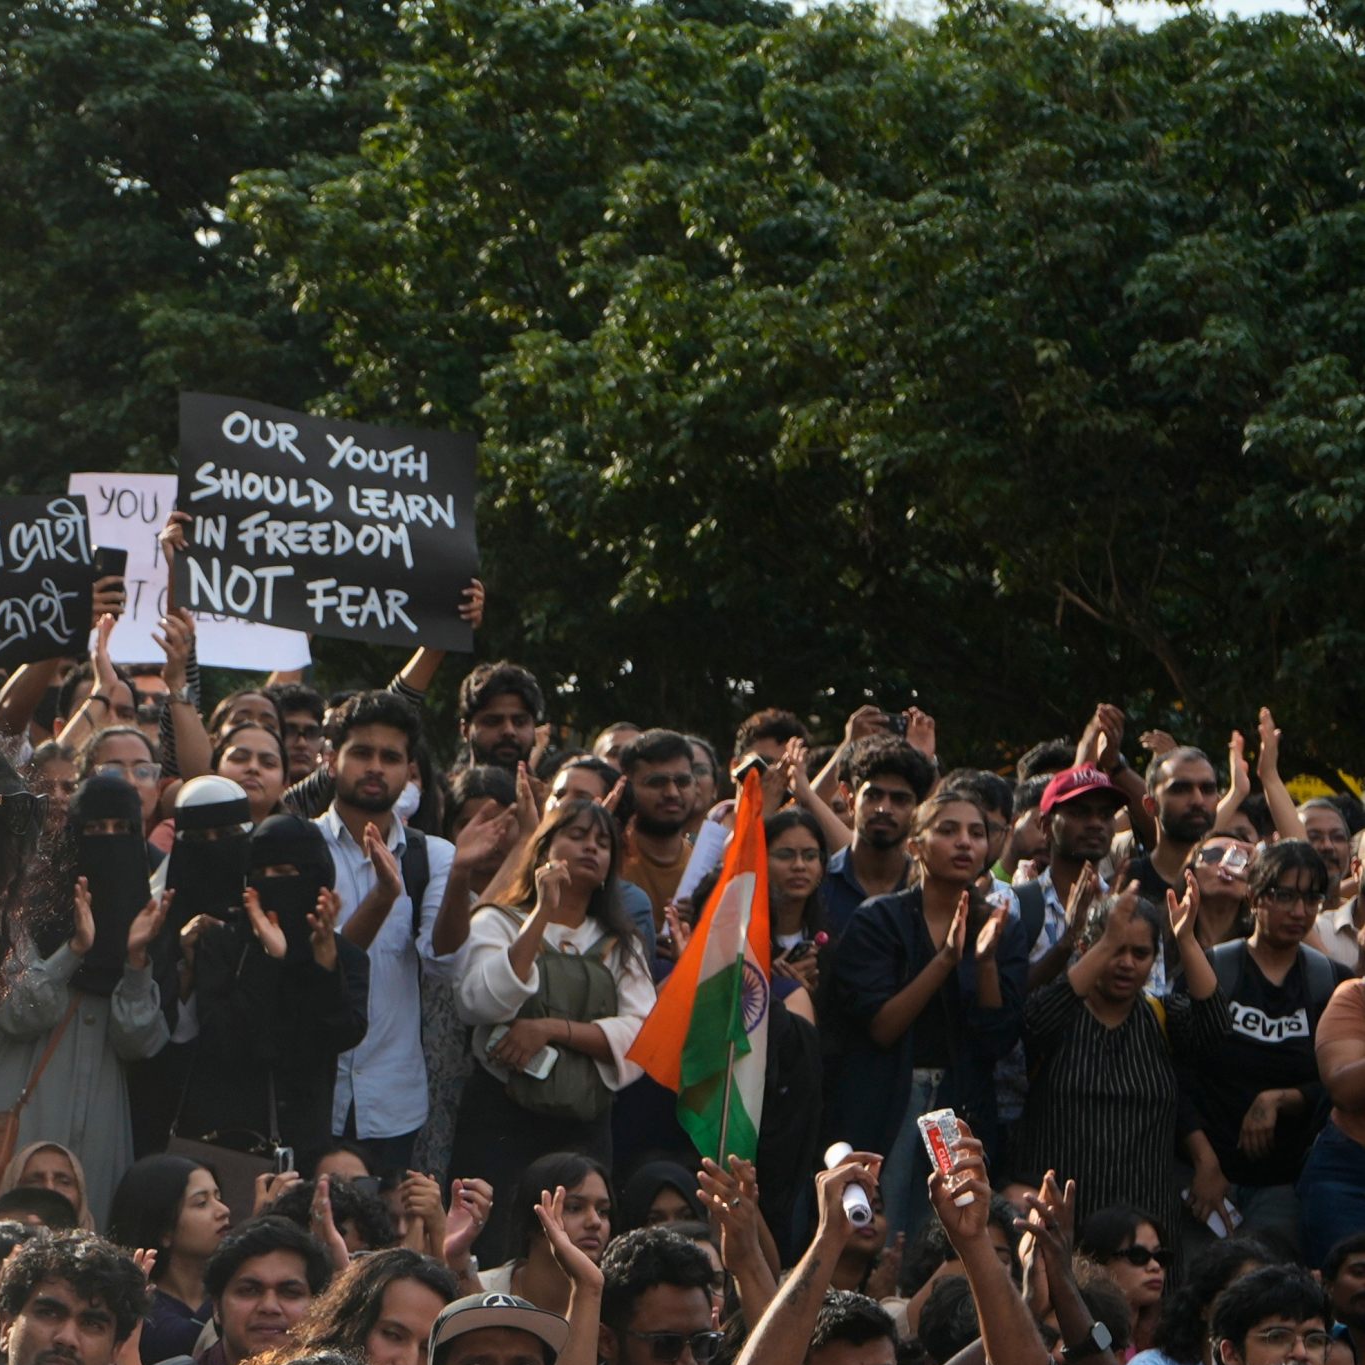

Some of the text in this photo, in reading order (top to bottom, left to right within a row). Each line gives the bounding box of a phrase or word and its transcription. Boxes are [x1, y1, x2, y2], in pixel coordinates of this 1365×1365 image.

[221, 410, 428, 484] OUR YOUTH
[98, 485, 159, 525] YOU
[189, 461, 456, 529] SHOULD LEARN
[194, 514, 227, 551] IN
[237, 511, 414, 569] FREEDOM
[186, 556, 295, 620] NOT
[306, 577, 419, 634] FEAR
